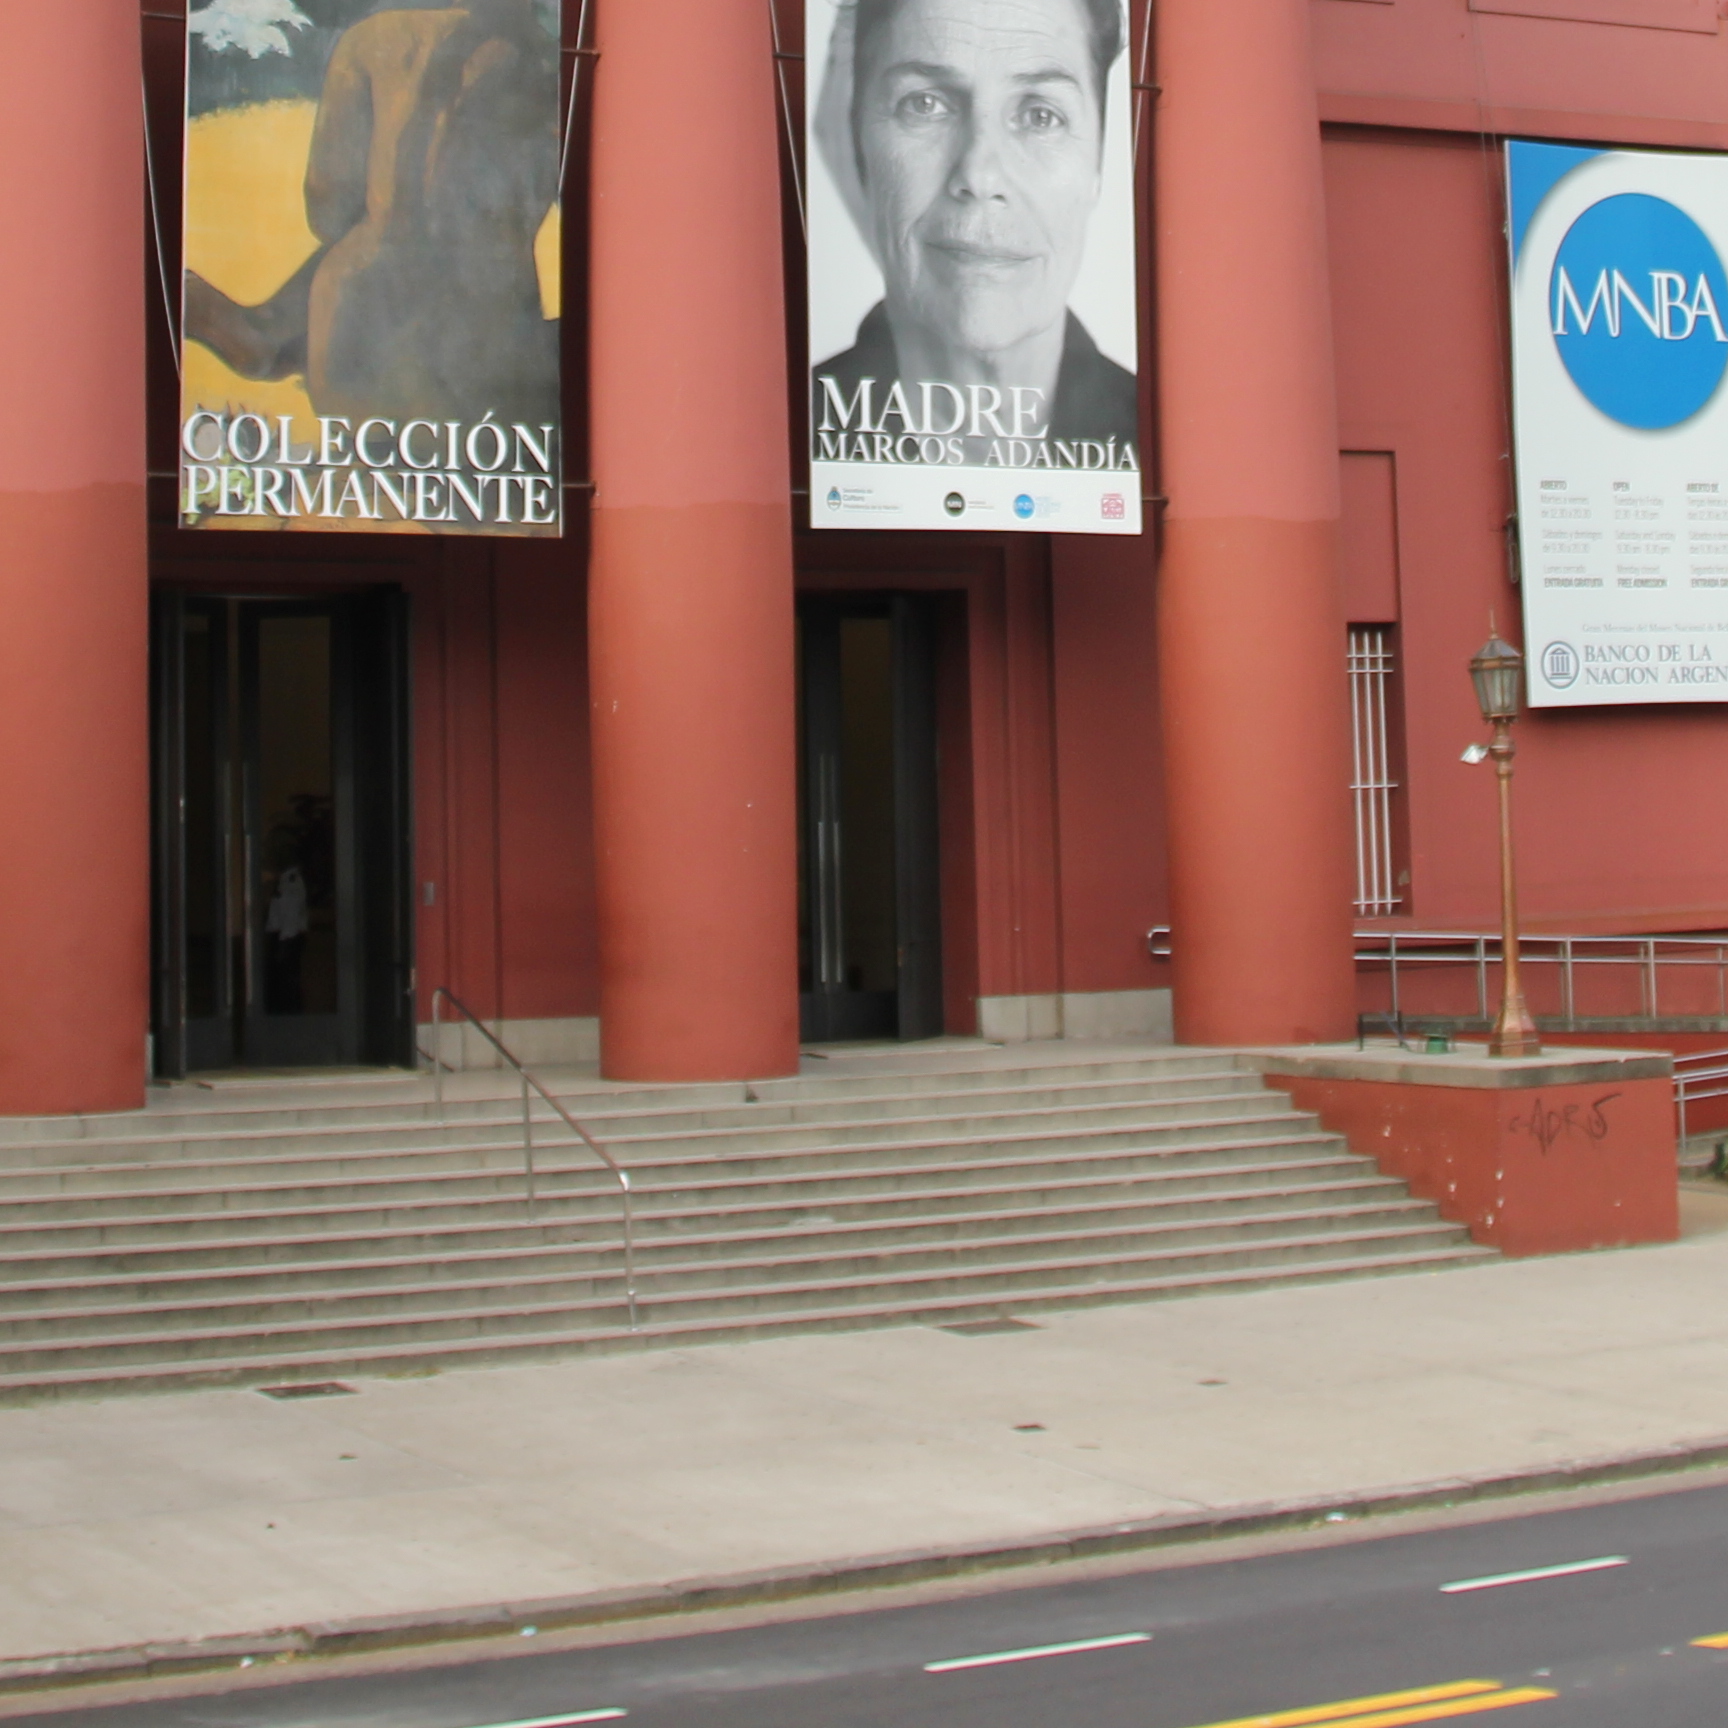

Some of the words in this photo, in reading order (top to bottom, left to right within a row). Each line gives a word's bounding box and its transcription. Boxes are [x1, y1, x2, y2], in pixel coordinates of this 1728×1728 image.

[818, 376, 1049, 439] MADRE
[182, 410, 554, 473] COLECCIÓN
[818, 432, 964, 465] MARCOS
[985, 436, 1138, 470] ADANDÍA
[182, 464, 555, 525] PERMANENTE
[1584, 644, 1650, 664] BANCO
[1658, 643, 1681, 662] DE
[1689, 643, 1712, 662] LA
[1585, 666, 1659, 686] NACION
